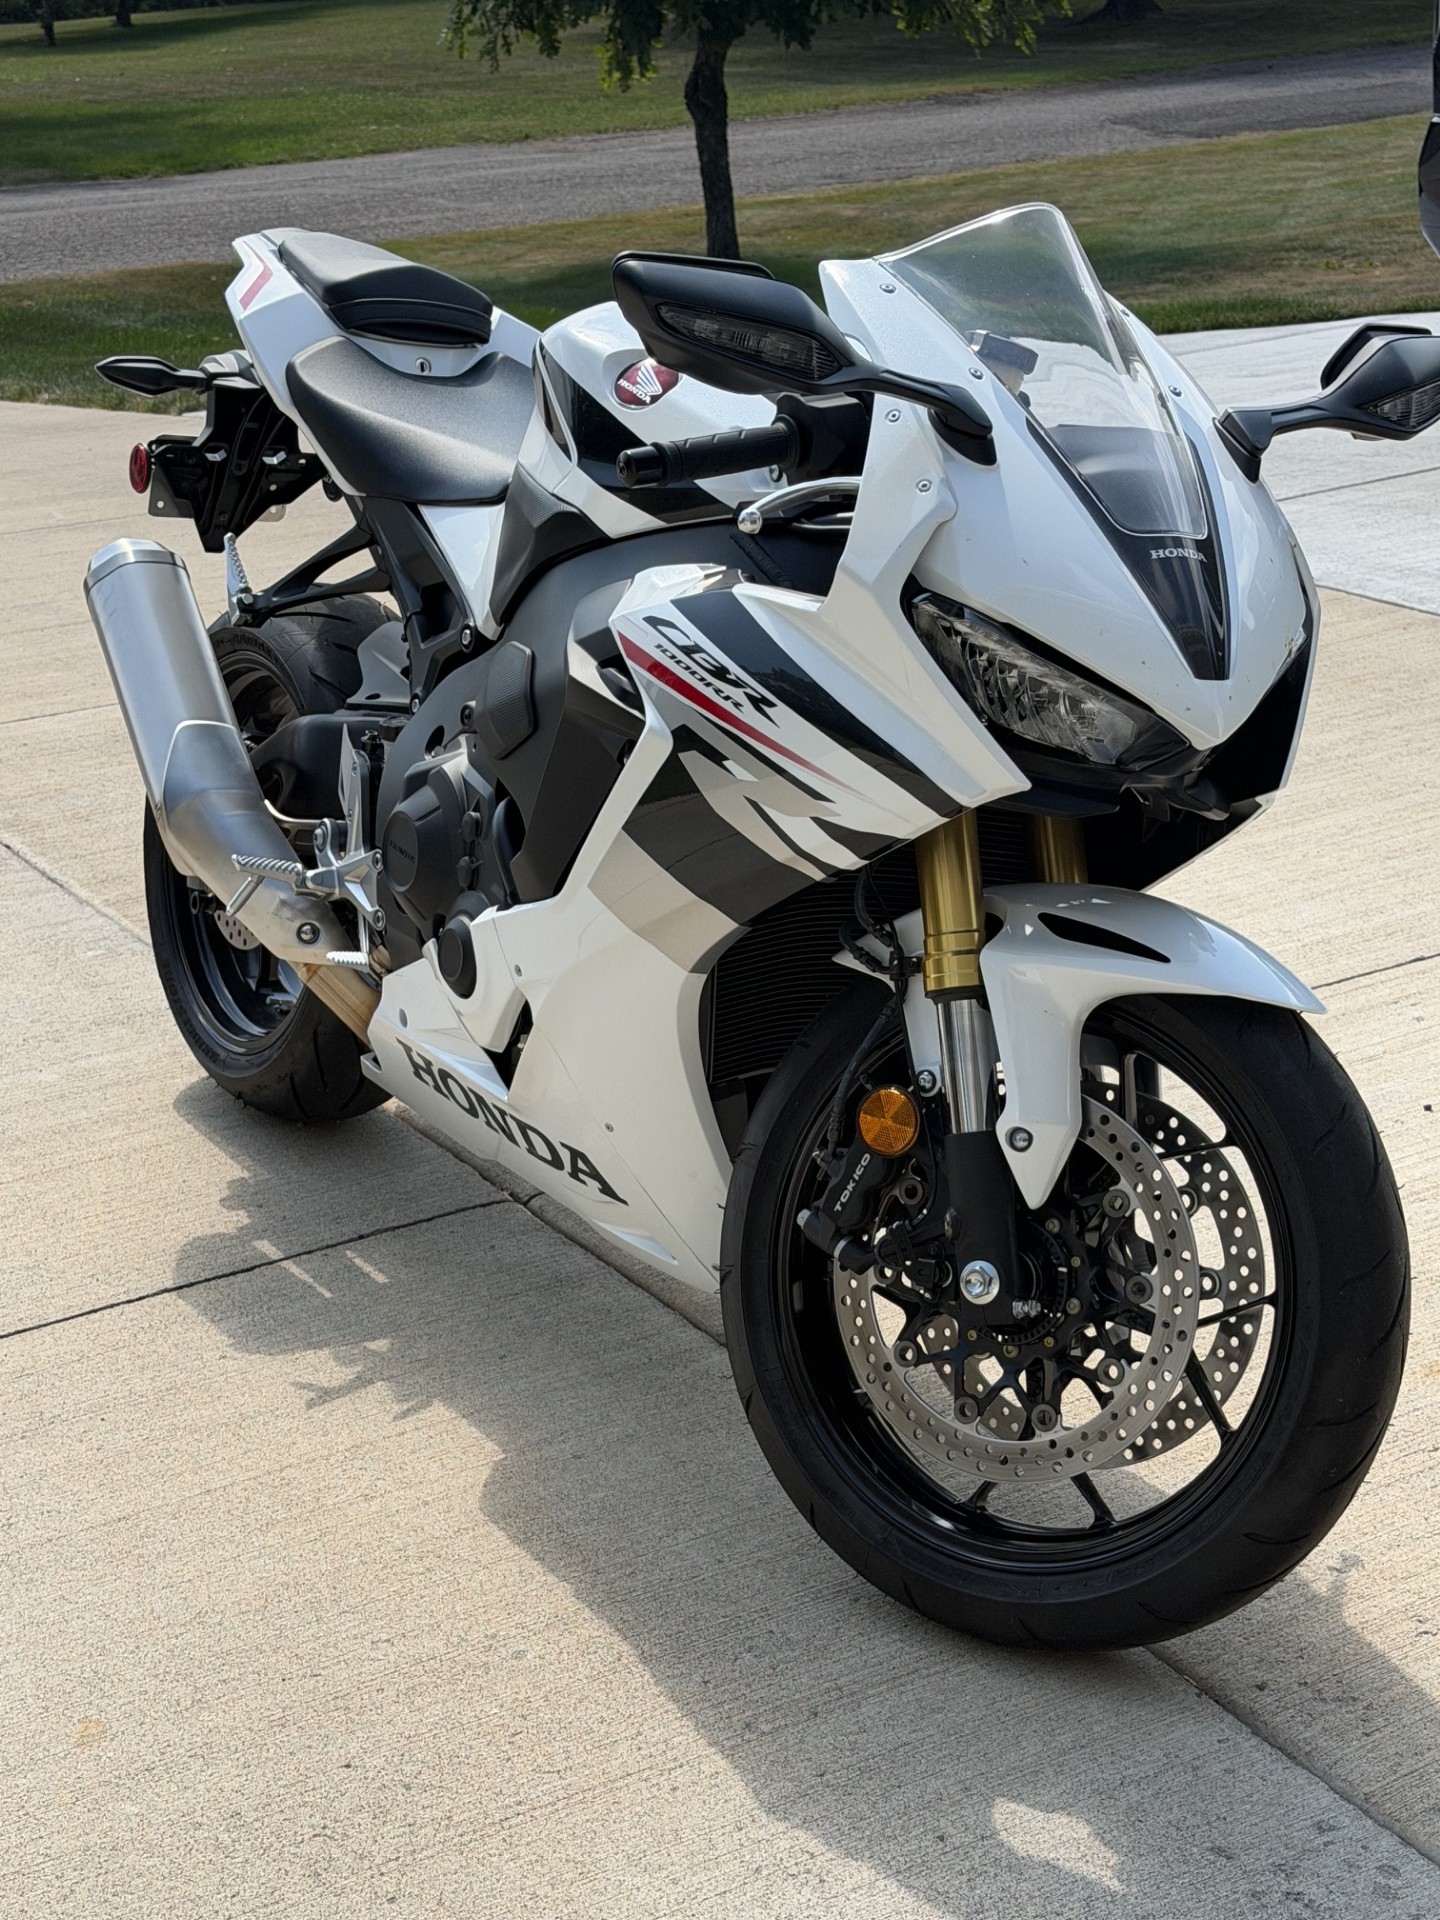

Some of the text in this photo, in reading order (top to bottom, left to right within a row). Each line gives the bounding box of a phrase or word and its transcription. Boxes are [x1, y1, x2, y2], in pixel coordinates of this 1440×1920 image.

[617, 378, 651, 404] HONDA
[1149, 548, 1208, 563] HONDA
[642, 615, 781, 729] CBR
[653, 643, 745, 715] 1000RR
[394, 1036, 630, 1207] HONDA
[833, 1152, 871, 1212] TOKICO
